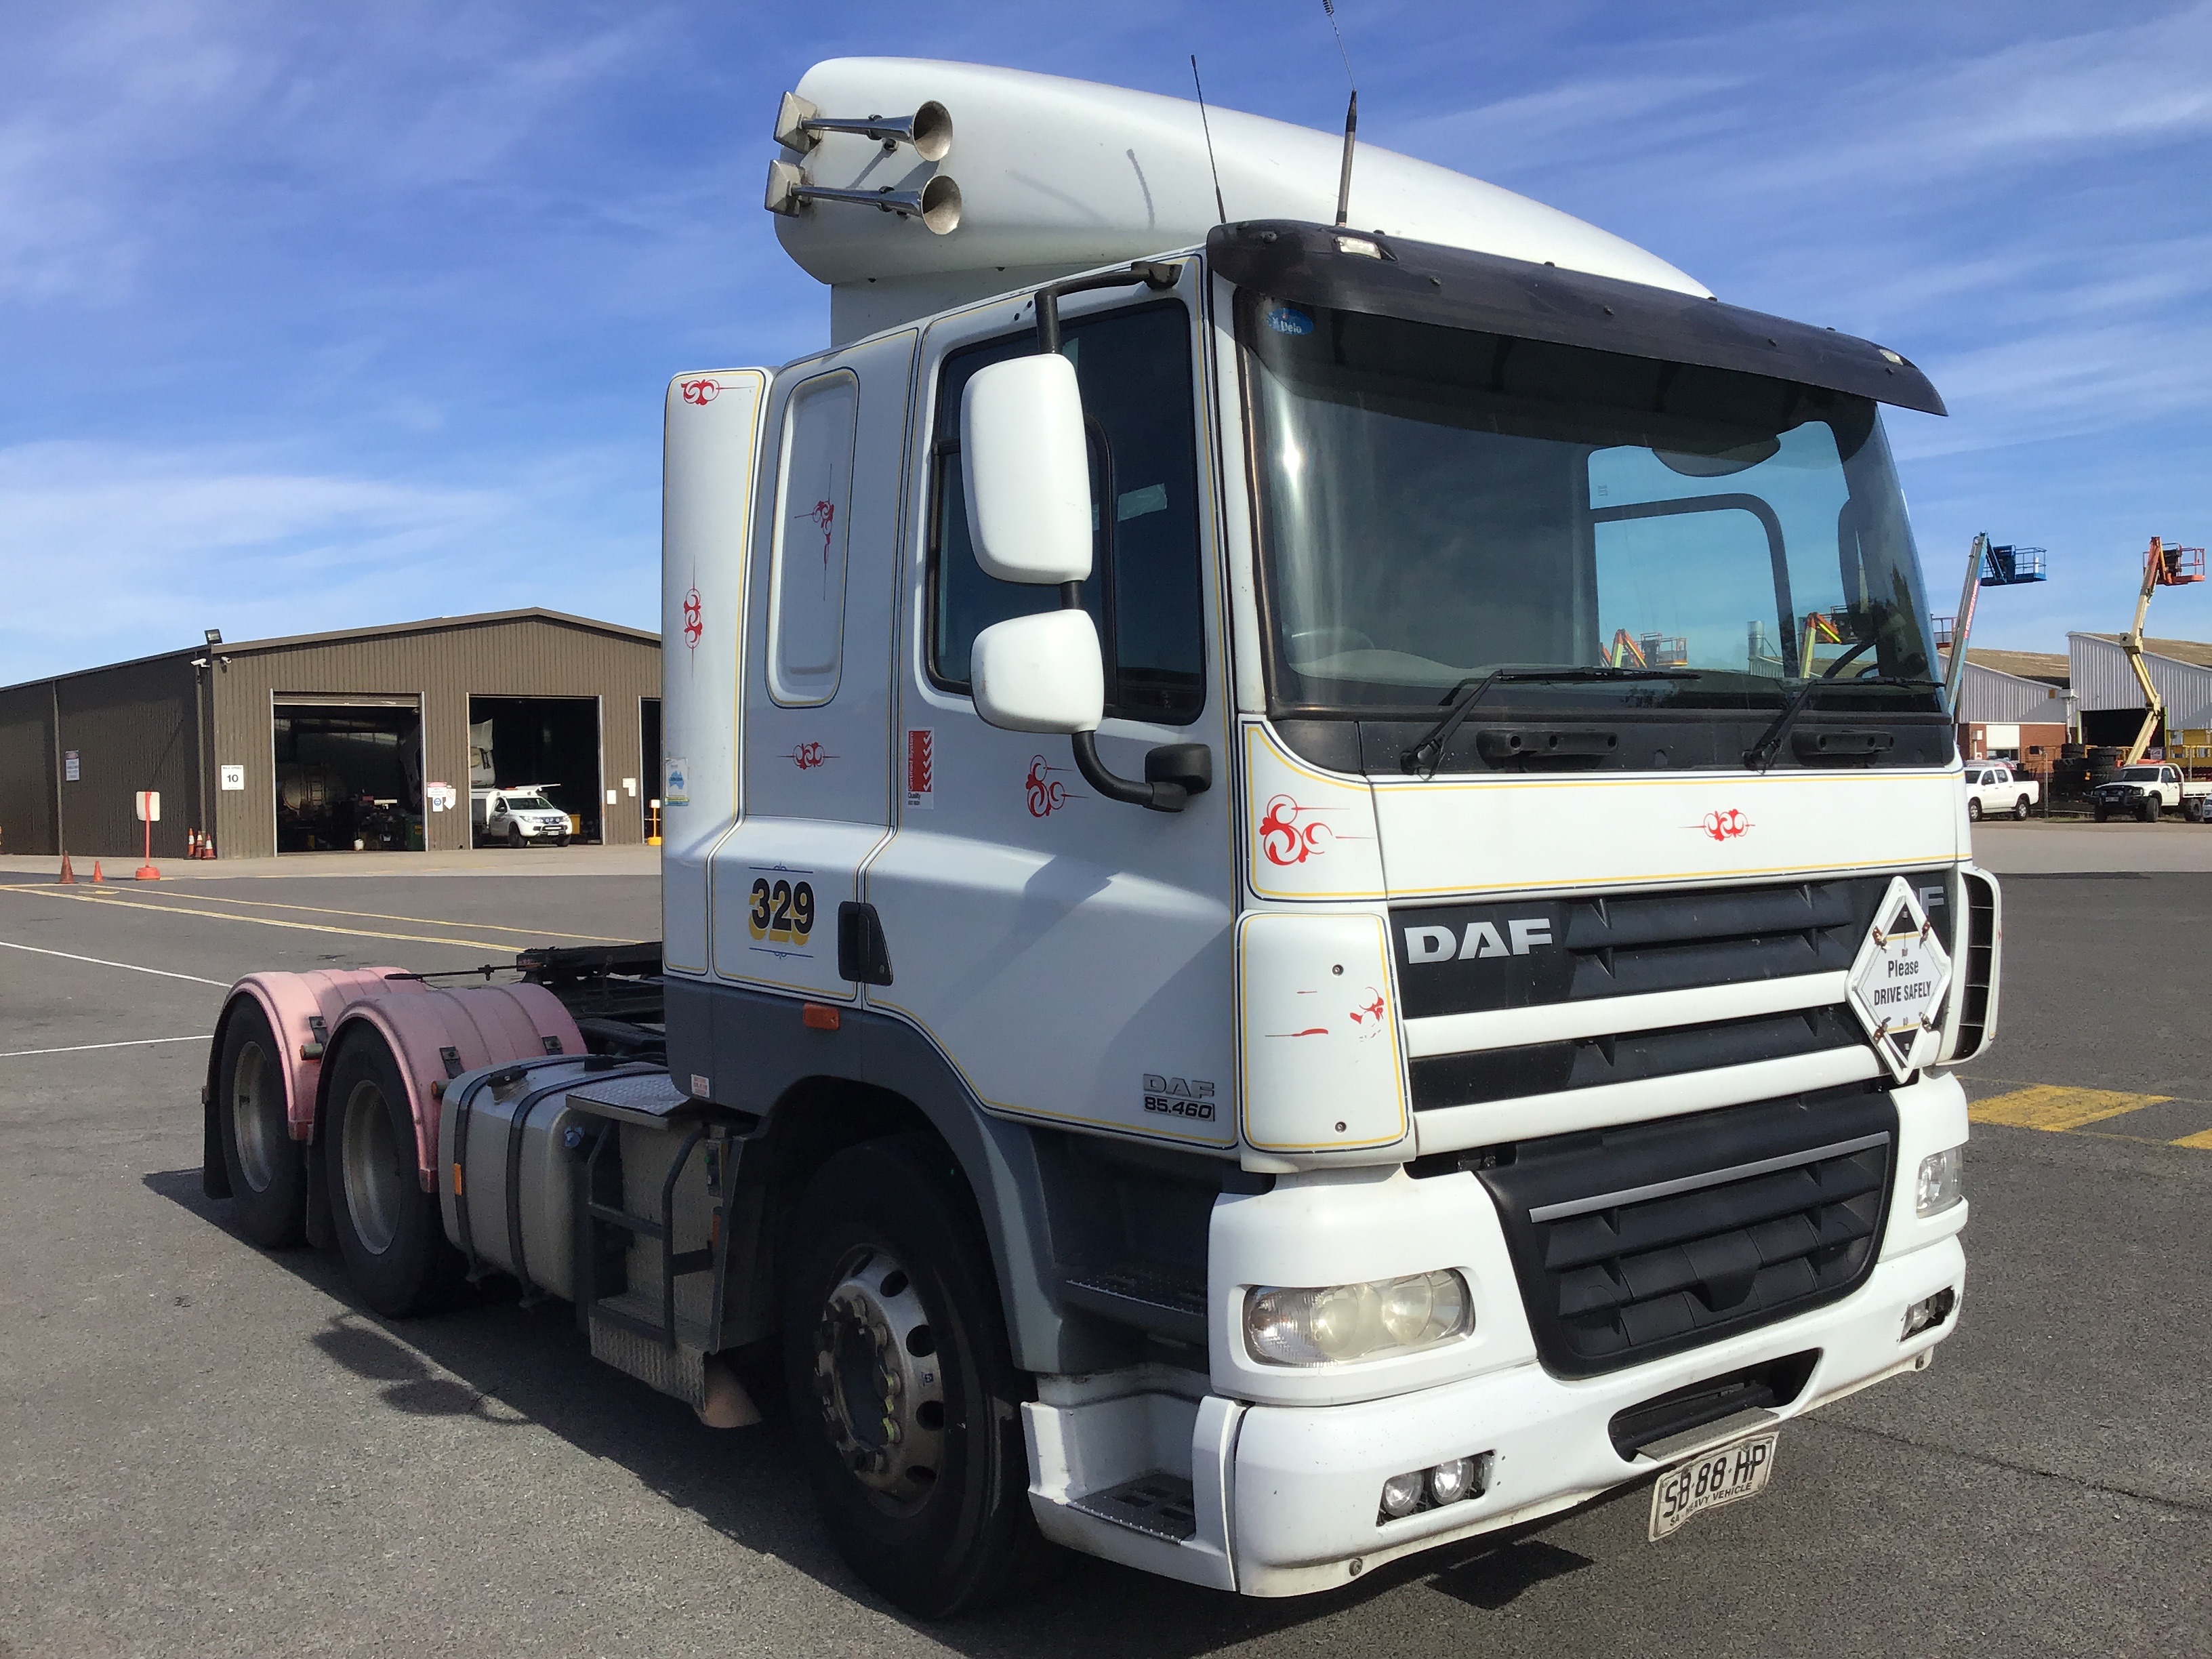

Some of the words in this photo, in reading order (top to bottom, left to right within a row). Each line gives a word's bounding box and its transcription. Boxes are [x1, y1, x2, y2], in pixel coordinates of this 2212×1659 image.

[1280, 320, 1303, 334] Delo
[226, 774, 239, 783] 10
[749, 878, 815, 939] 329
[1404, 918, 1553, 964] DAF
[1887, 960, 1919, 979] Please
[1873, 985, 1902, 1006] DRIVE
[1904, 981, 1932, 1002] SAFELY
[1143, 1073, 1215, 1099] DAF
[1144, 1096, 1213, 1119] 85.460
[1669, 1514, 1680, 1527] SA
[1712, 1481, 1753, 1501] VEHICLE
